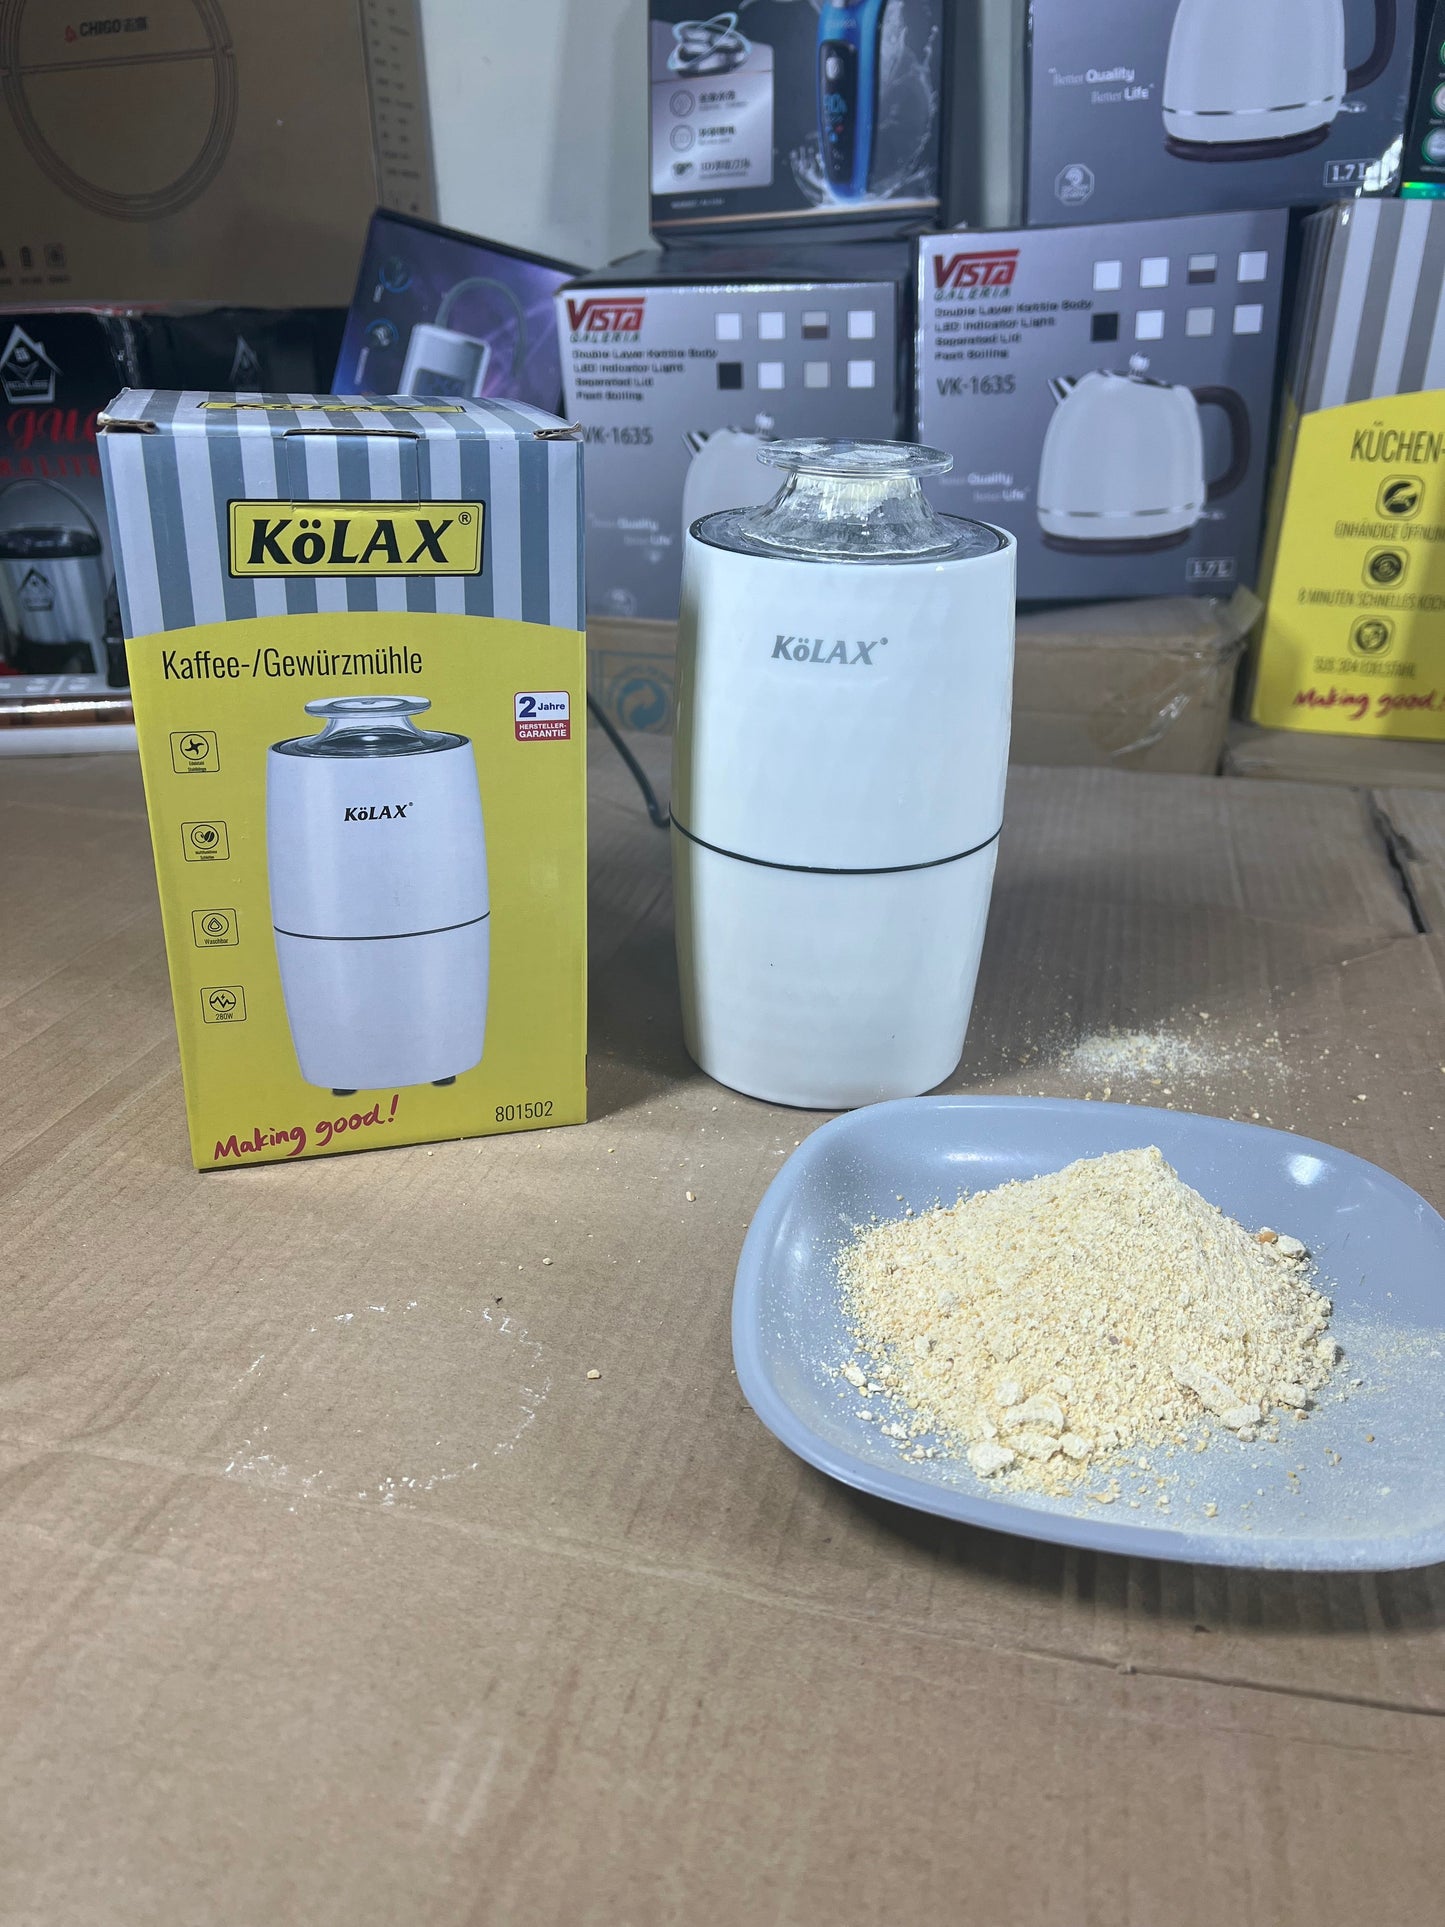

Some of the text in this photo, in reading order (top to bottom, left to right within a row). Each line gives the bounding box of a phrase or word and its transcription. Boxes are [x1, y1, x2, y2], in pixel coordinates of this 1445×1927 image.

[80, 19, 121, 37] CHIGO
[1085, 66, 1134, 83] Quality
[933, 249, 1020, 288] VISTA
[565, 297, 646, 331] VISTA
[935, 307, 975, 317] Double
[979, 305, 1012, 316] Layer
[1061, 299, 1094, 311] Body
[935, 316, 1055, 332] LED Indicator Light
[687, 348, 719, 359] Body
[937, 375, 1016, 395] VK-1635
[582, 425, 654, 445] VK-1635
[162, 646, 423, 680] Kaffee-/Gewürzmühle
[519, 696, 566, 718] 2 Jahre
[1293, 685, 1370, 720] Making
[519, 729, 567, 738] GARANTIE
[215, 1013, 234, 1021] 280W
[495, 1101, 553, 1122] 801502
[213, 1094, 399, 1161] Making good!
